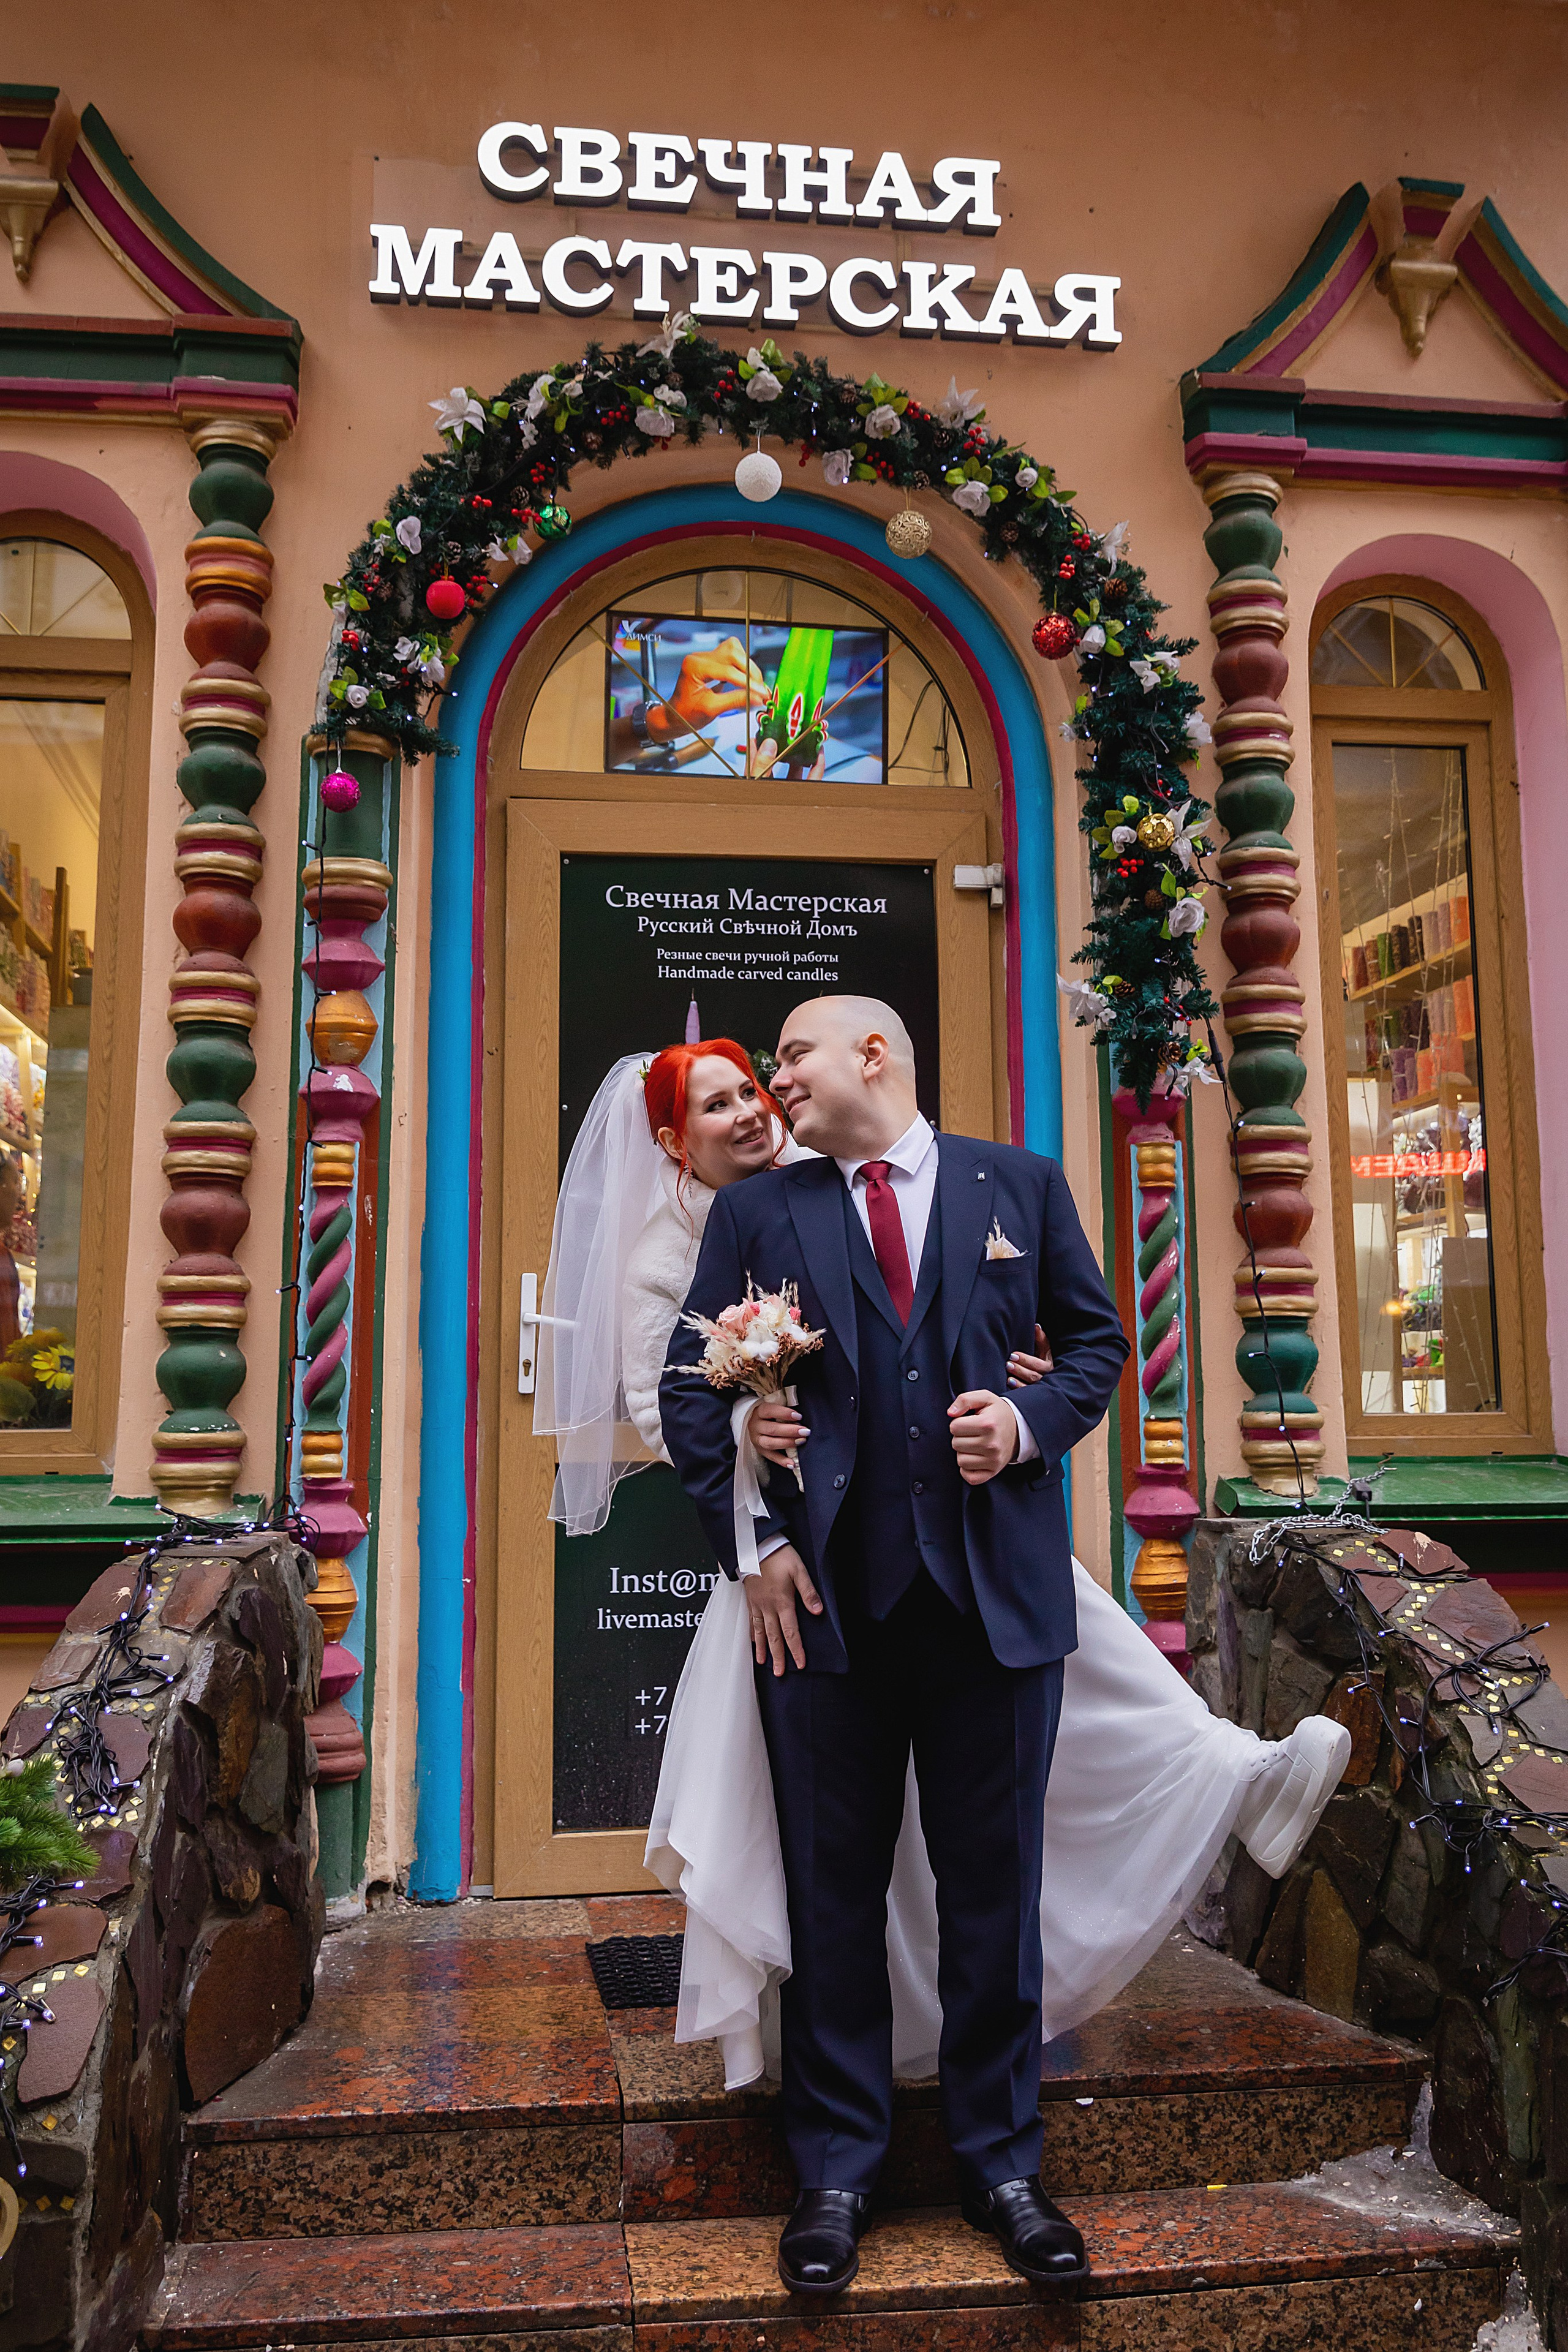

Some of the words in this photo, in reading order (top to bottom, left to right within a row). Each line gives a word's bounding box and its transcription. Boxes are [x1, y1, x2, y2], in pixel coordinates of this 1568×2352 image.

[477, 121, 1002, 227] СВЕЧНАЯ
[369, 224, 1123, 344] МАСТЕРСКАЯ
[605, 885, 720, 910] Свечная
[728, 888, 888, 918] Мастерская
[638, 916, 714, 937] Русский
[719, 918, 802, 935] Свѣчной
[806, 920, 858, 940] Домъ
[657, 948, 703, 960] Резные
[705, 952, 741, 961] свечи
[744, 950, 790, 964] ручной
[793, 951, 839, 965] работы
[658, 965, 734, 979] Handmade
[737, 967, 783, 980] carved
[786, 968, 839, 981] candles
[635, 1686, 667, 1706] +7
[635, 1715, 667, 1735] +7
